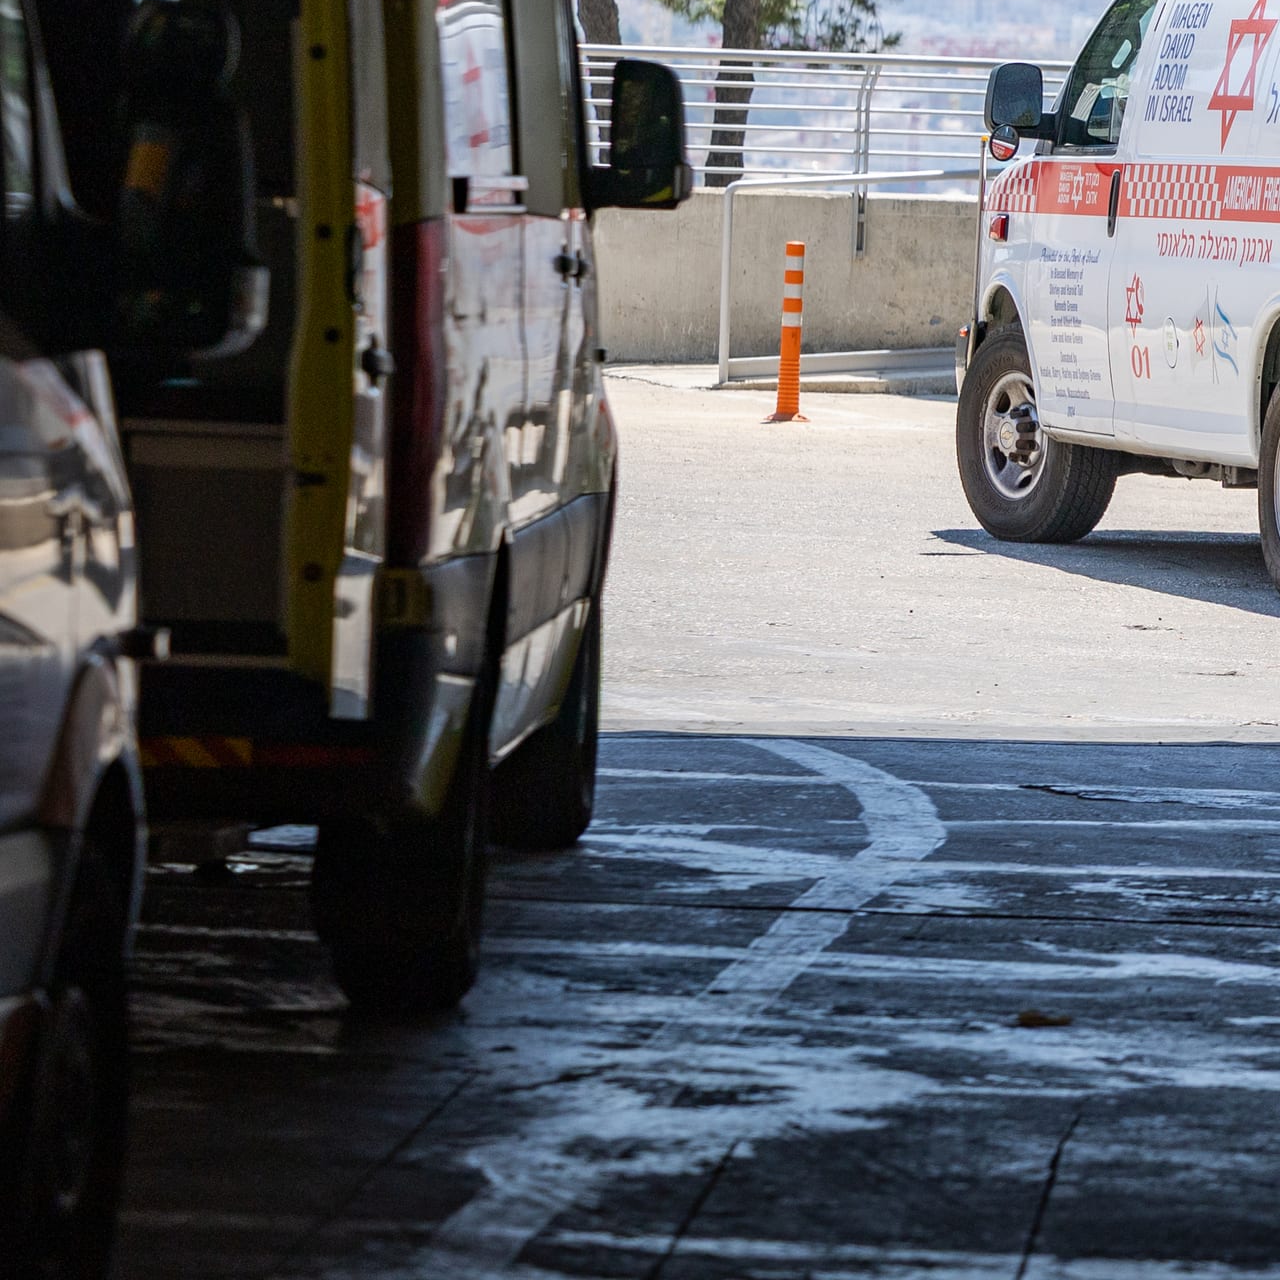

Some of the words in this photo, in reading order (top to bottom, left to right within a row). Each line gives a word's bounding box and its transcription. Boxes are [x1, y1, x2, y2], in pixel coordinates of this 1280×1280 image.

[1169, 2, 1214, 30] MAGEN
[1159, 33, 1195, 59] DAVID
[1151, 64, 1188, 91] ADOM
[1144, 95, 1158, 122] IN
[1159, 95, 1194, 123] ISRAEL
[1223, 175, 1263, 211] AMERICAN
[1157, 228, 1195, 258] הלאומי
[1198, 229, 1238, 261] ההצלה
[1239, 238, 1273, 268] ארגון
